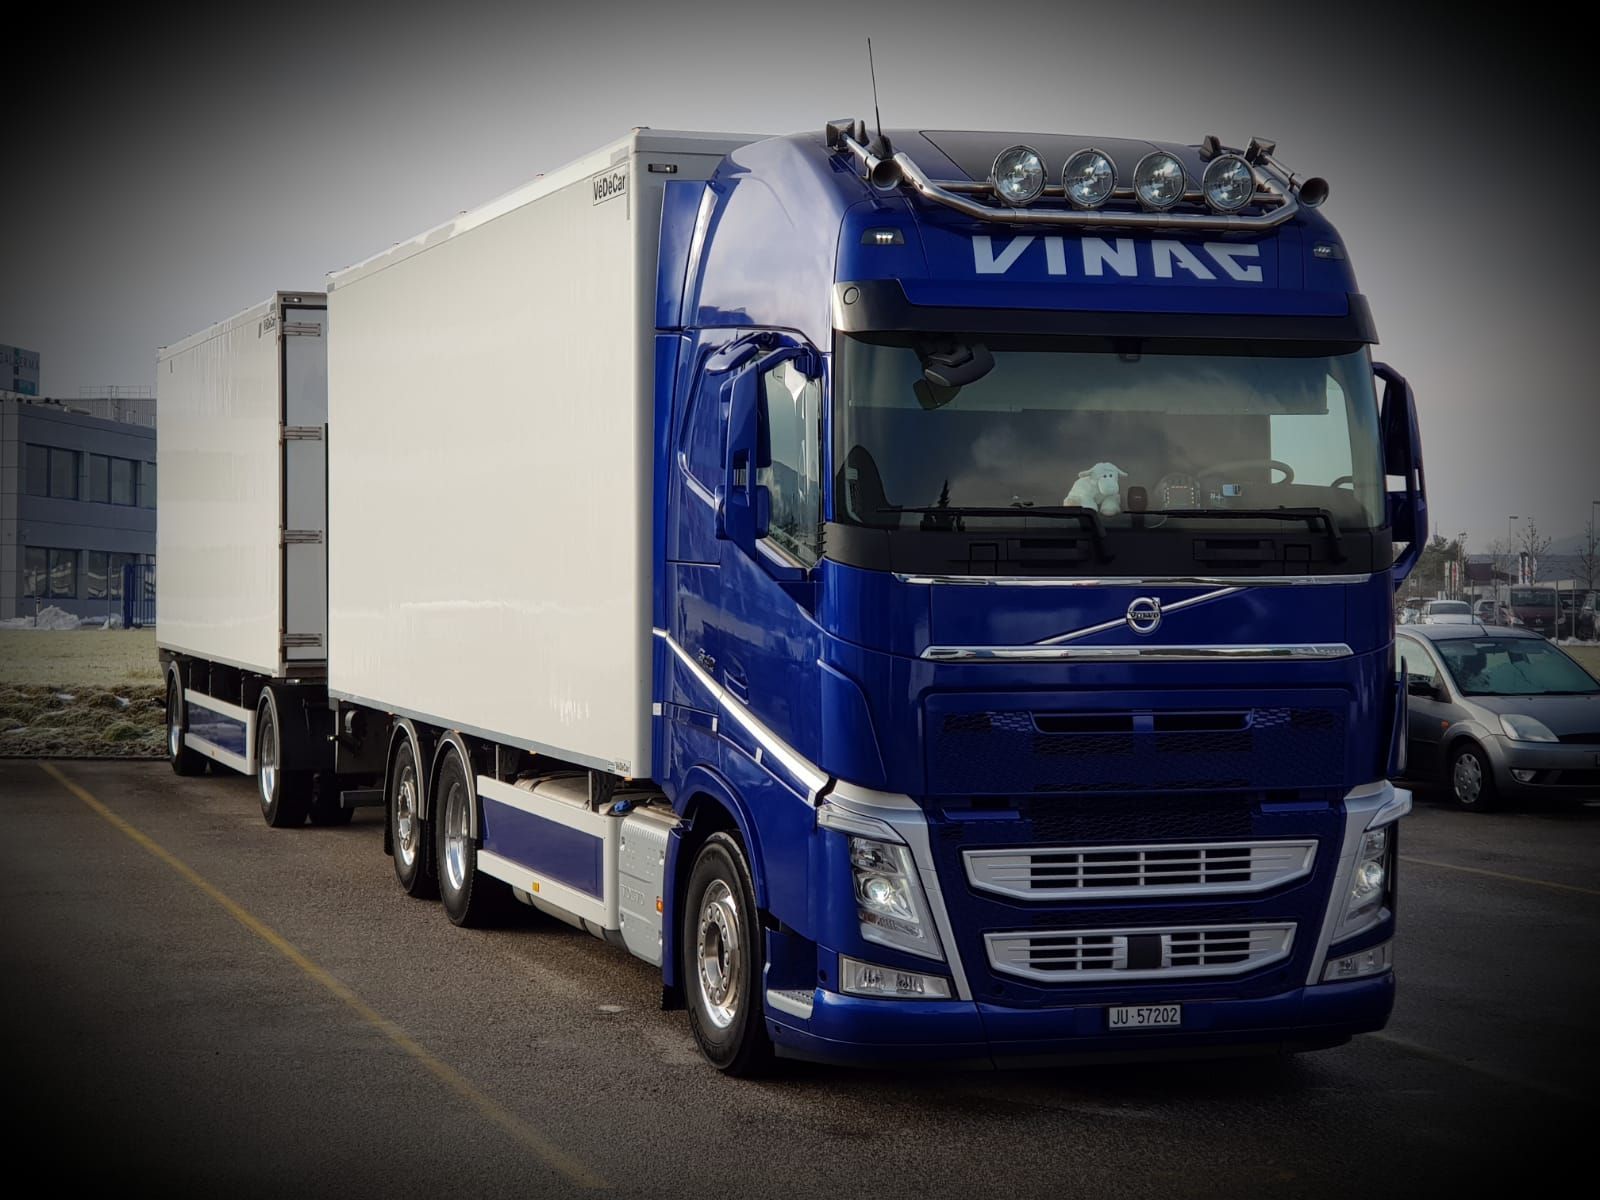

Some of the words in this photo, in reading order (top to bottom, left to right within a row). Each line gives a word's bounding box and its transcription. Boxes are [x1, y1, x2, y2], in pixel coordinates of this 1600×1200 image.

[972, 235, 1264, 282] VINAG
[1113, 1009, 1128, 1024] JU
[1137, 1007, 1178, 1023] 57202
